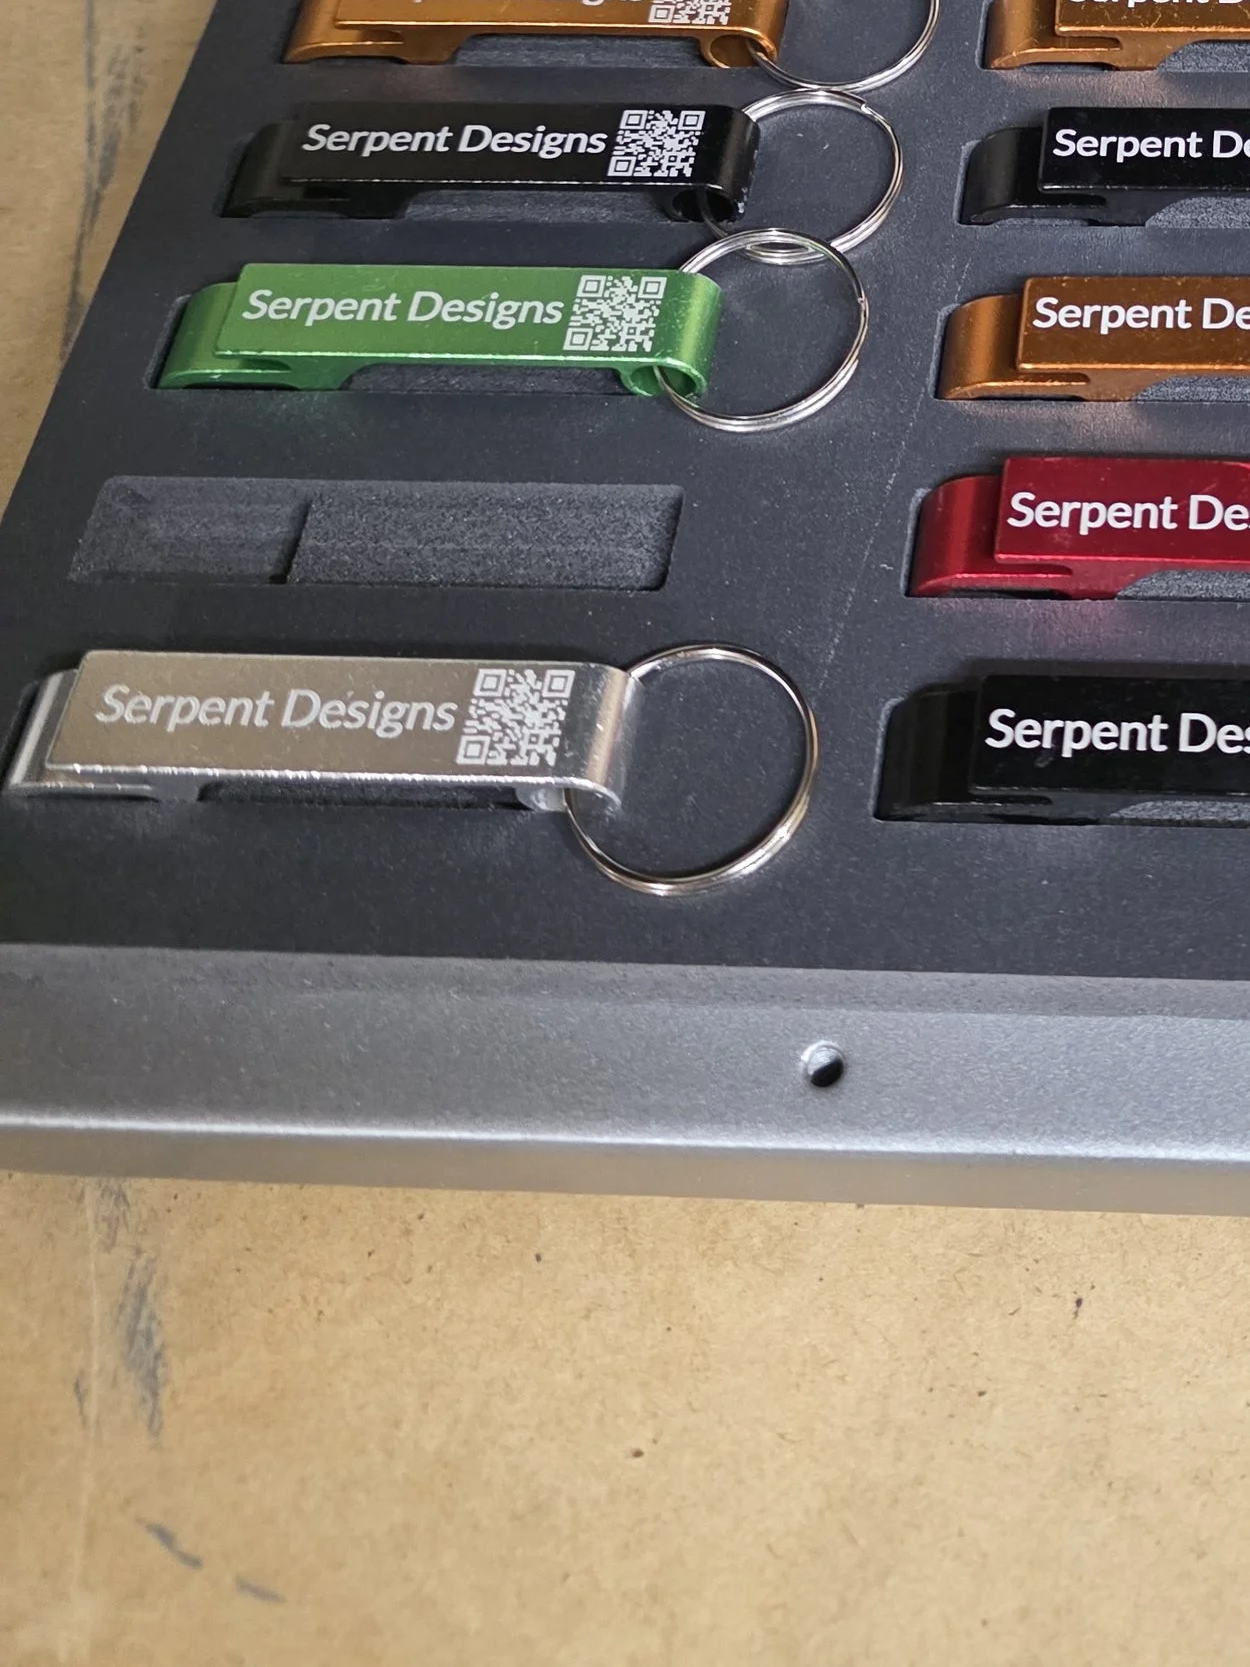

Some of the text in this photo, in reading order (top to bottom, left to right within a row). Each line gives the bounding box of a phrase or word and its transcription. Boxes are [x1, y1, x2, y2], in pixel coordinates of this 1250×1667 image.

[303, 124, 608, 158] Serpent Designs
[1053, 129, 1202, 162] Serpent
[242, 290, 564, 329] Serpent Designs
[1033, 297, 1192, 334] Serpent
[1007, 492, 1178, 535] Serpent
[95, 685, 458, 738] Serpent Designs
[985, 709, 1168, 757] Serpent
